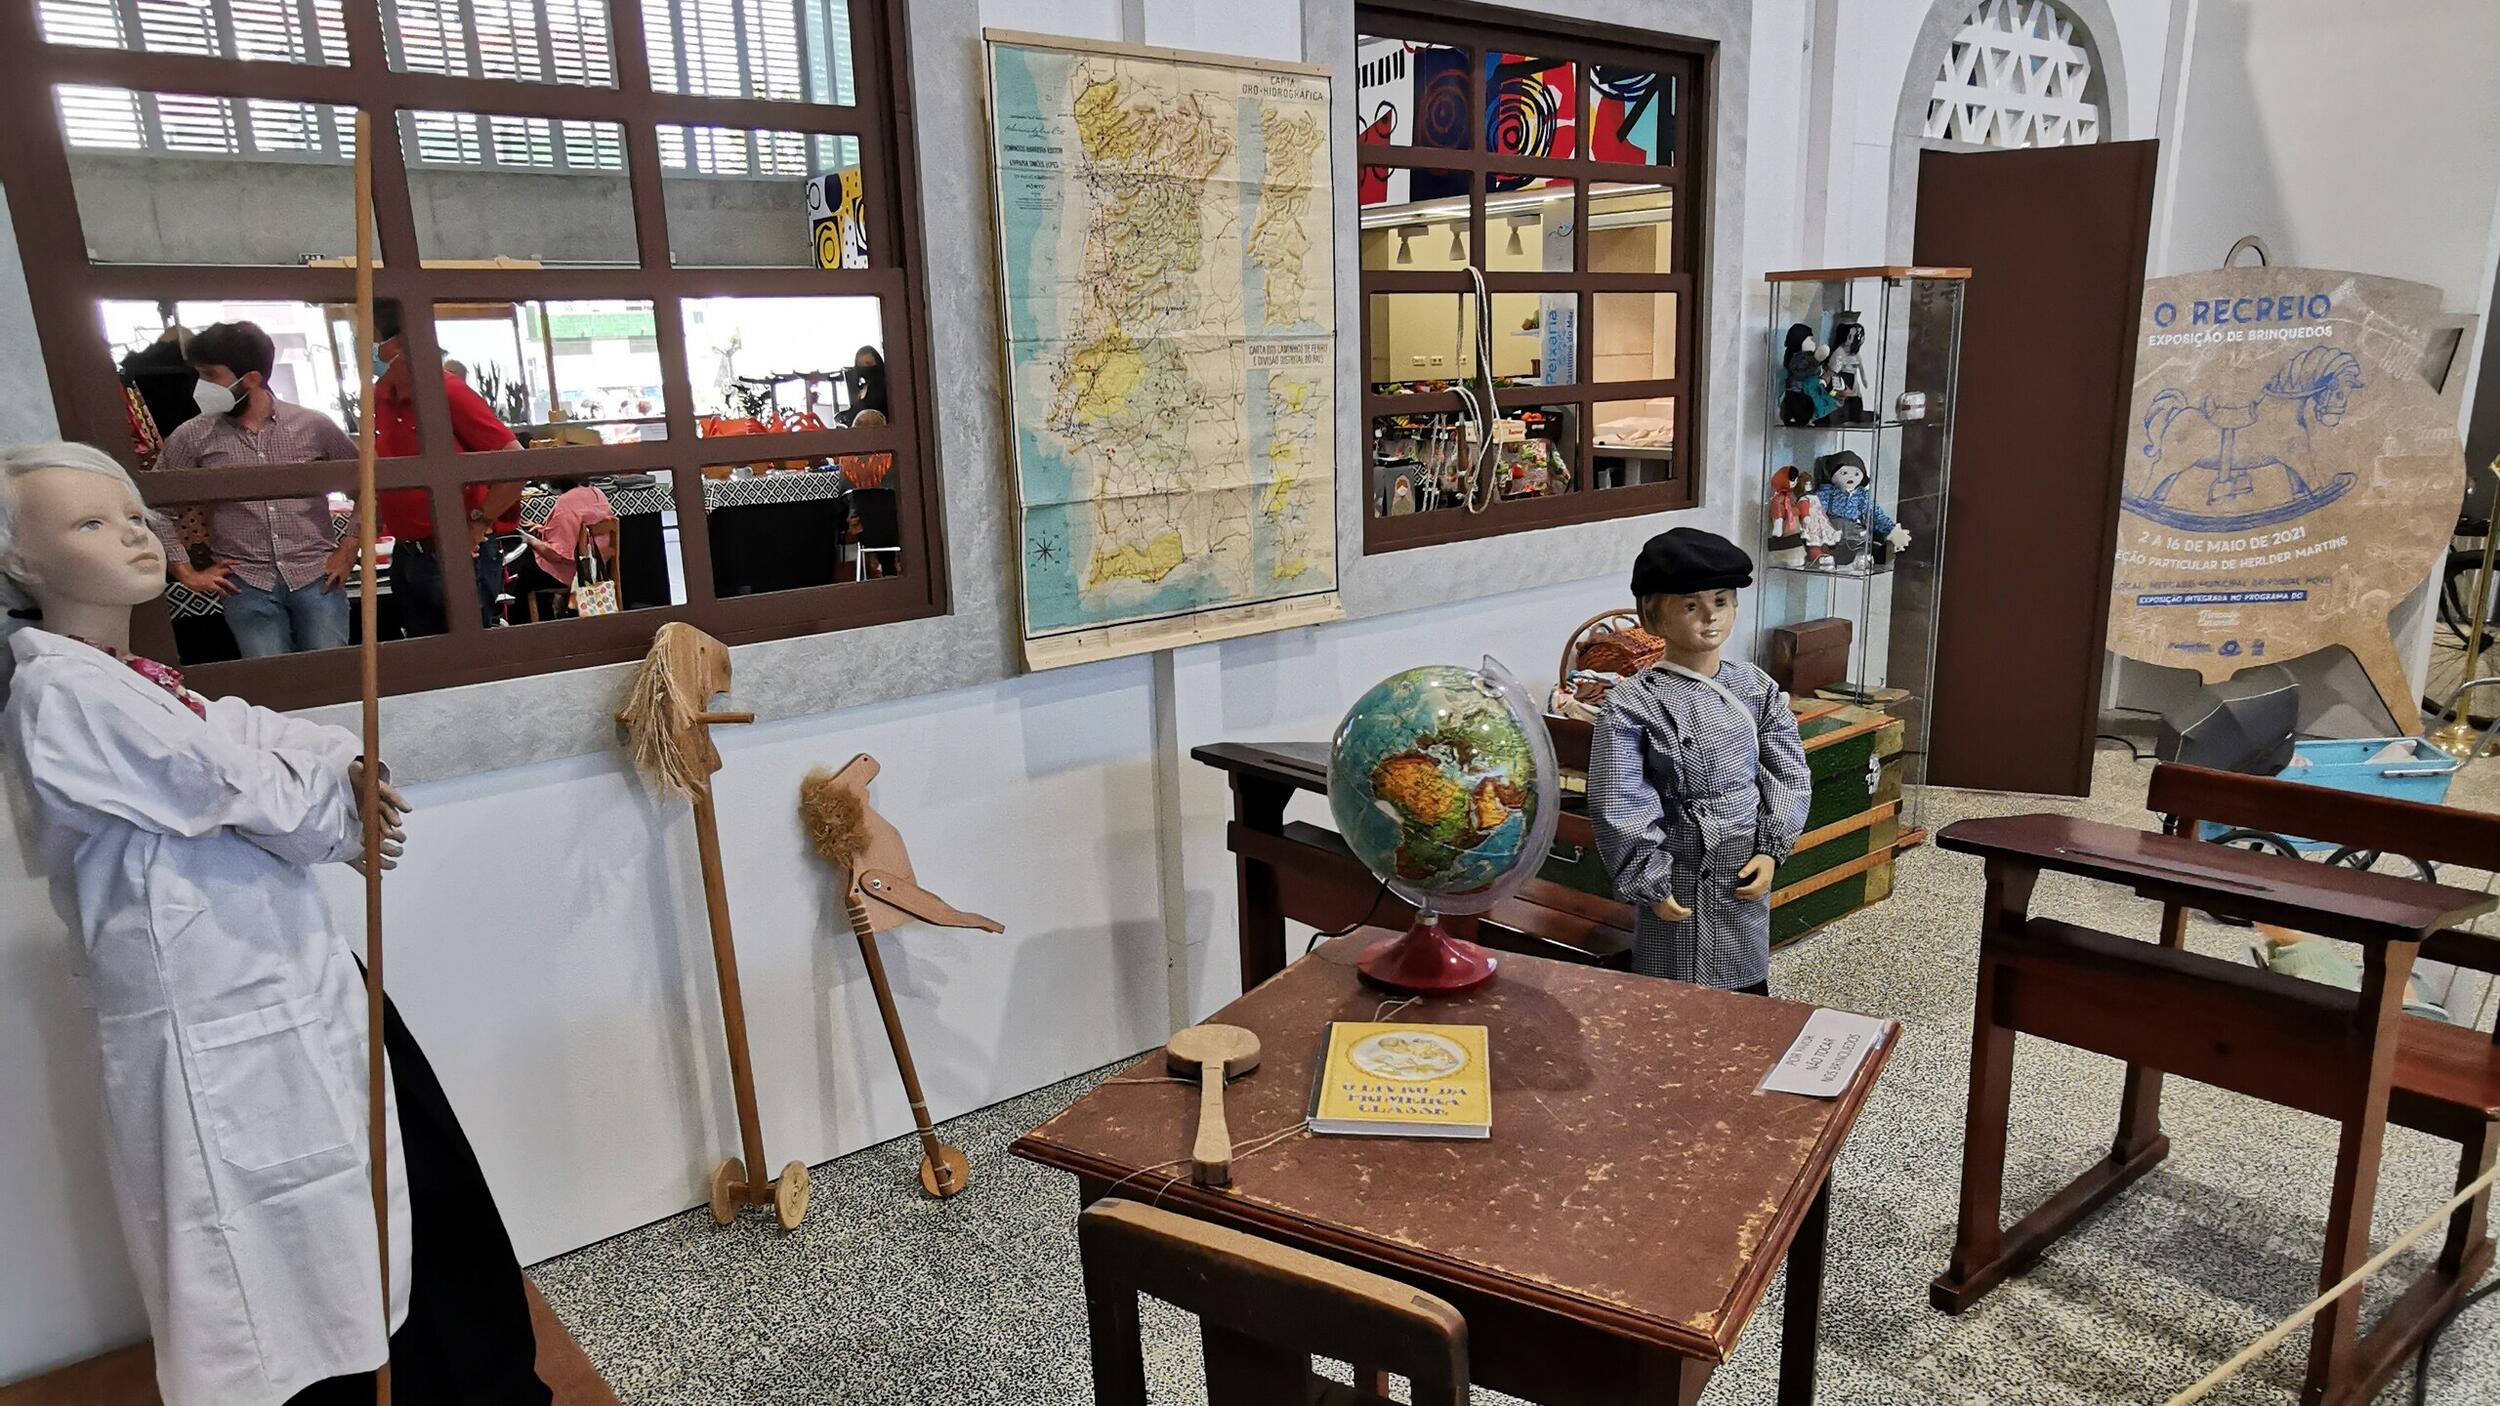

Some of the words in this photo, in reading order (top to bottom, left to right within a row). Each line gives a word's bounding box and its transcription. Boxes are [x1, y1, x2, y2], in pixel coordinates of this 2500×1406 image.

[1270, 76, 1295, 87] CARTA
[2154, 302, 2177, 328] O
[2192, 294, 2332, 325] RECREIO
[1546, 310, 1557, 384] Peixaria
[2150, 331, 2223, 347] EXPOSIÇÃO
[2227, 331, 2244, 342] DE
[2249, 326, 2333, 342] BRINQUEDOS
[2138, 531, 2150, 544] 2
[2152, 535, 2162, 546] A
[2167, 537, 2180, 551] 16
[2184, 540, 2203, 553] DE
[2207, 539, 2246, 553] MAIO
[2250, 536, 2268, 550] DE
[2272, 526, 2306, 545] 2021
[2115, 549, 2146, 565] EÇÃO
[2148, 557, 2218, 570] PARTICULAR
[2222, 559, 2237, 570] DE
[2240, 551, 2292, 568] HERLDER
[2295, 535, 2349, 559] MARTINS
[2139, 595, 2182, 605] EXPOSIÇÃO
[2184, 594, 2228, 603] INTEGRADA
[2230, 594, 2242, 602] NO
[2244, 592, 2289, 601] PROGRAMA
[2291, 591, 2304, 600] DO
[1805, 1058, 1823, 1071] NÃO
[1814, 1037, 1834, 1058] TOCAR
[1829, 1033, 1861, 1071] BRINQUEDOS
[1342, 1083, 1355, 1091] O
[1362, 1084, 1428, 1094] LIVRO
[1439, 1087, 1467, 1096] DA
[1348, 1094, 1459, 1106] PRIMEIRA
[1359, 1103, 1449, 1116] CLASSE
